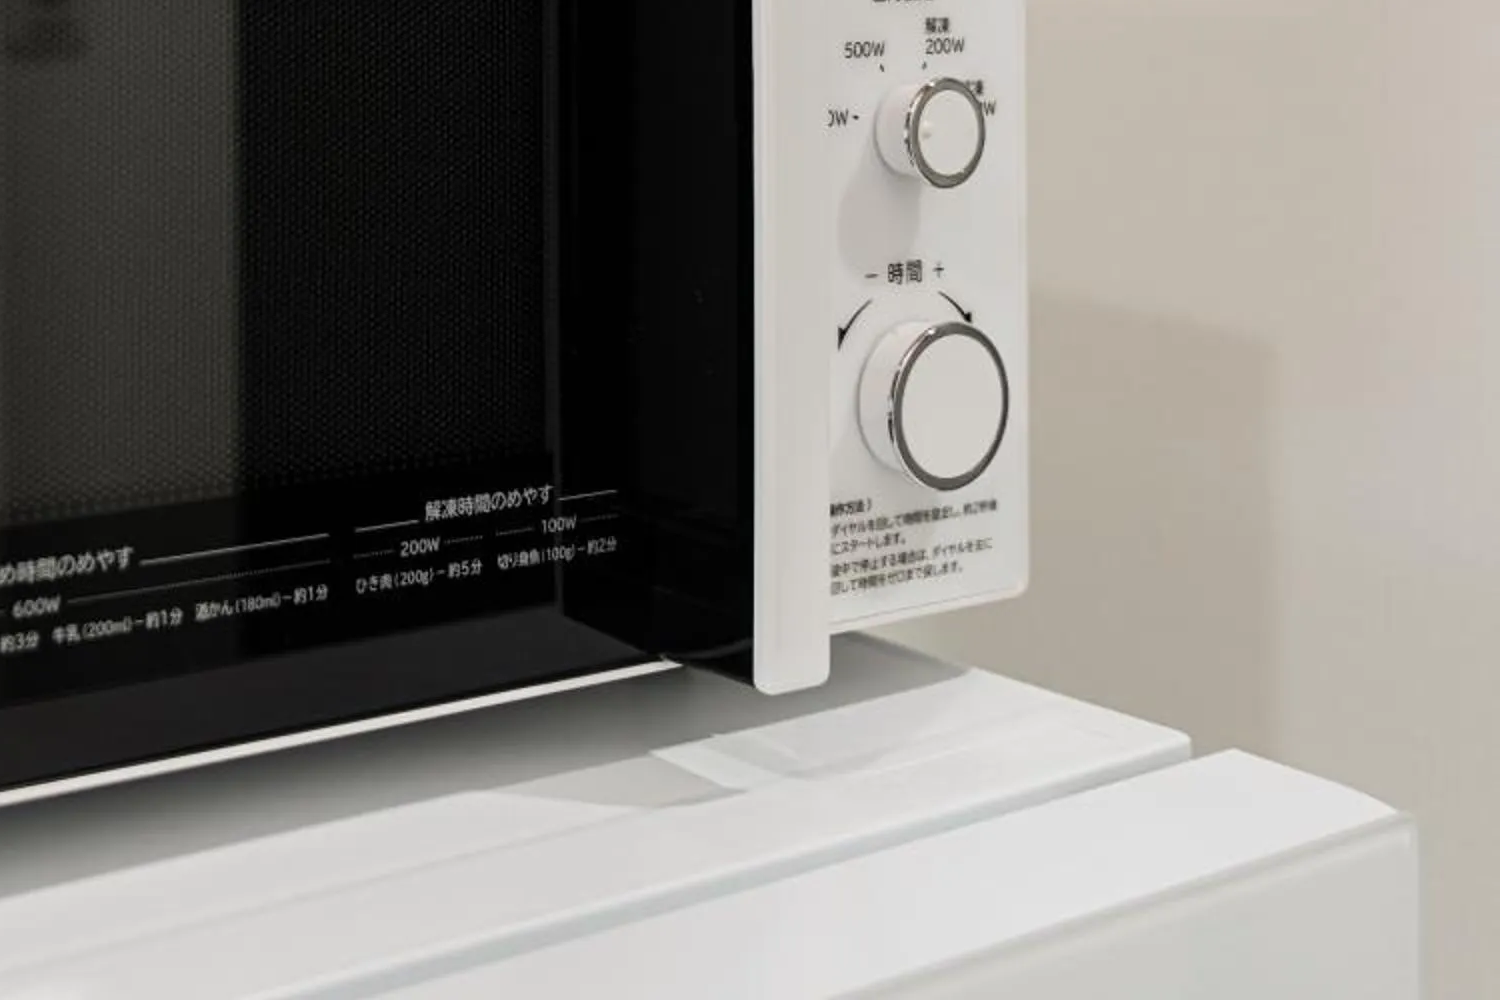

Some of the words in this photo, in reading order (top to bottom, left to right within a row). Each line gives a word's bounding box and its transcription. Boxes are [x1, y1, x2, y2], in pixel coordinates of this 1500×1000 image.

[844, 41, 885, 58] 500W
[925, 37, 965, 54] 200W
[887, 259, 923, 285] 時間
[425, 483, 554, 522] 解凍時間のめやす
[541, 514, 577, 533] 100W
[399, 536, 441, 558] 200W
[12, 595, 61, 618] 600W
